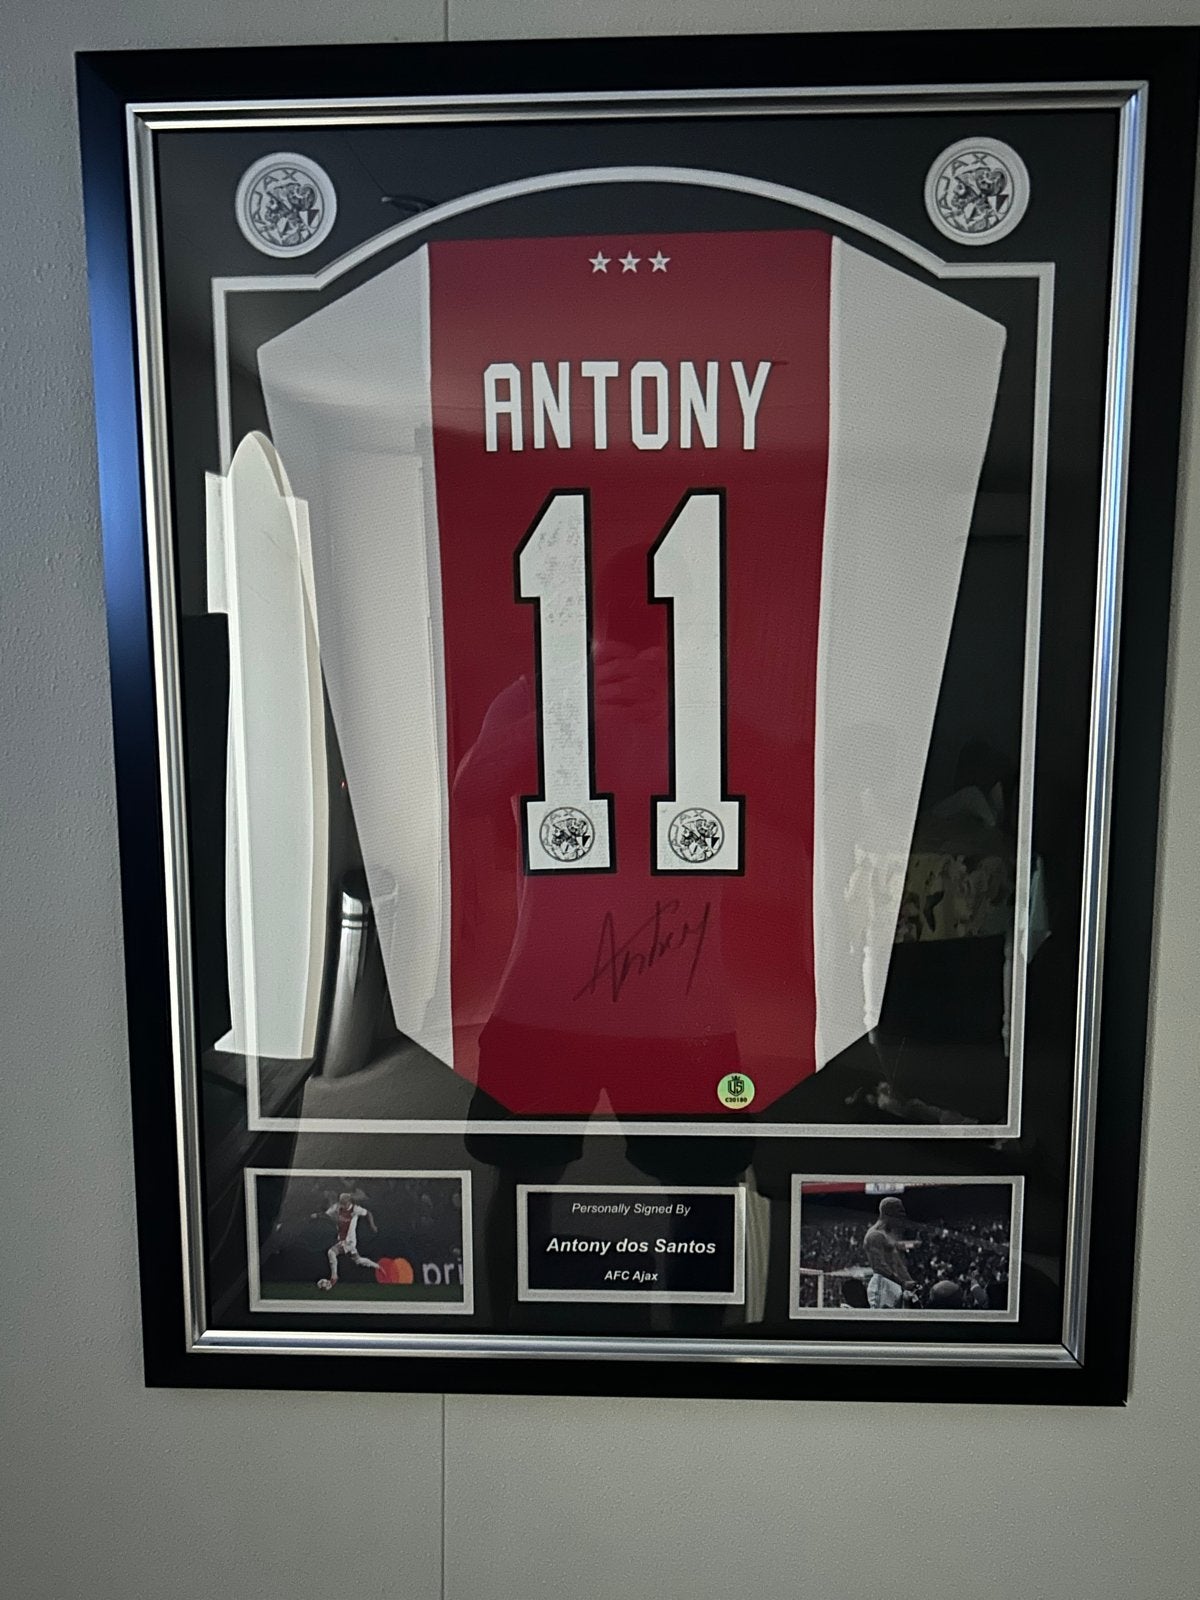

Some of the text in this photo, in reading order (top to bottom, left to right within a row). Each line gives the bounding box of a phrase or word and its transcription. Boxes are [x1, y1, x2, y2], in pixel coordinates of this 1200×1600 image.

[484, 361, 771, 451] ANTONY
[513, 488, 745, 876] 11
[571, 1202, 691, 1217] Personally Signed By
[546, 1237, 717, 1256] Antony dos Santos
[604, 1270, 658, 1283] AFC Ajax
